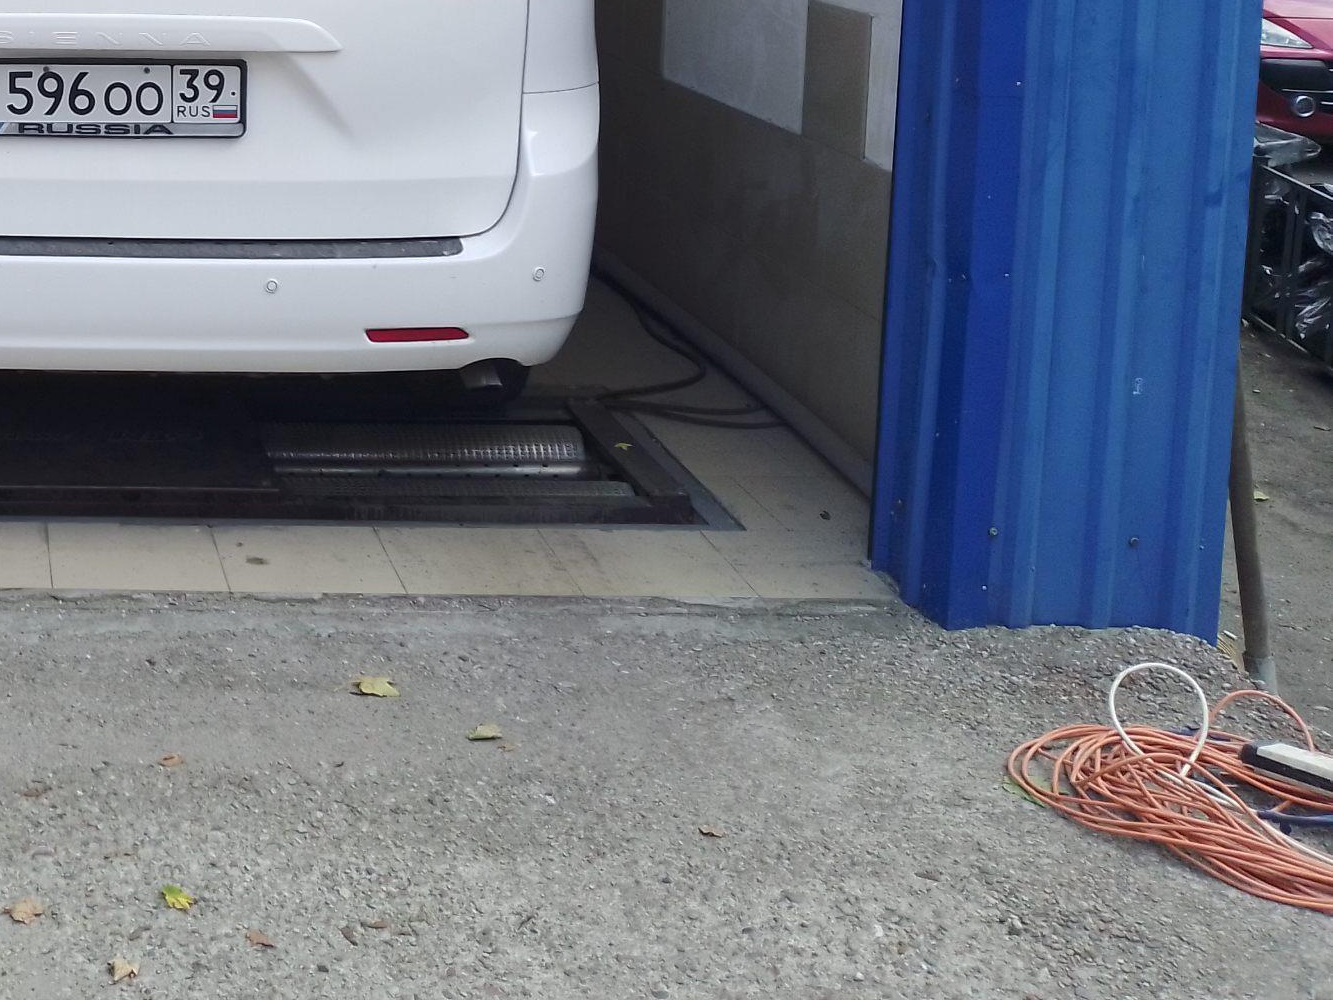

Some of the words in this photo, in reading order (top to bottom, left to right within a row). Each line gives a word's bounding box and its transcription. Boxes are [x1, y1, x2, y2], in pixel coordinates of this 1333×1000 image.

[178, 69, 225, 103] 39
[177, 106, 211, 118] RUS
[18, 122, 174, 135] RUSSIA
